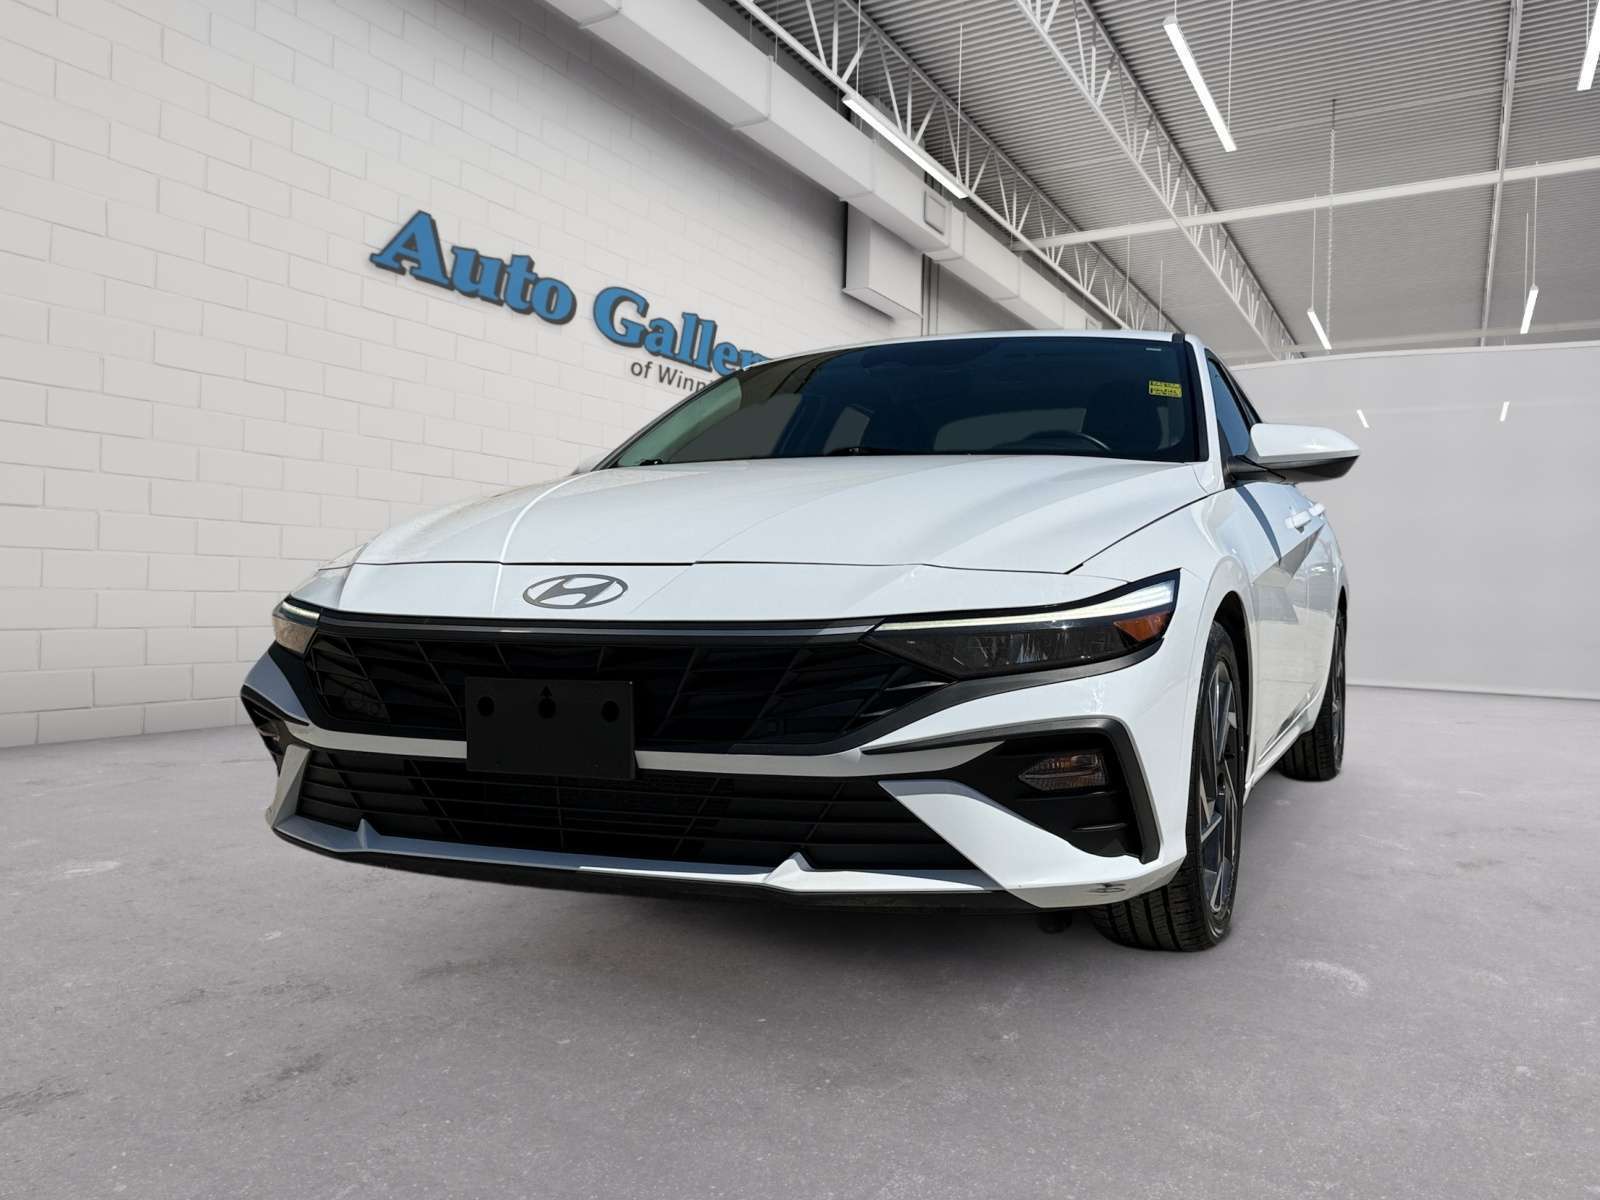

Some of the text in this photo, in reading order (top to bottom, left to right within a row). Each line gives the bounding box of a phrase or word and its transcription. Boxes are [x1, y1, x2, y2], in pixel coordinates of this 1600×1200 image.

[369, 209, 771, 377] Auto Galler
[630, 361, 713, 392] of Winn
